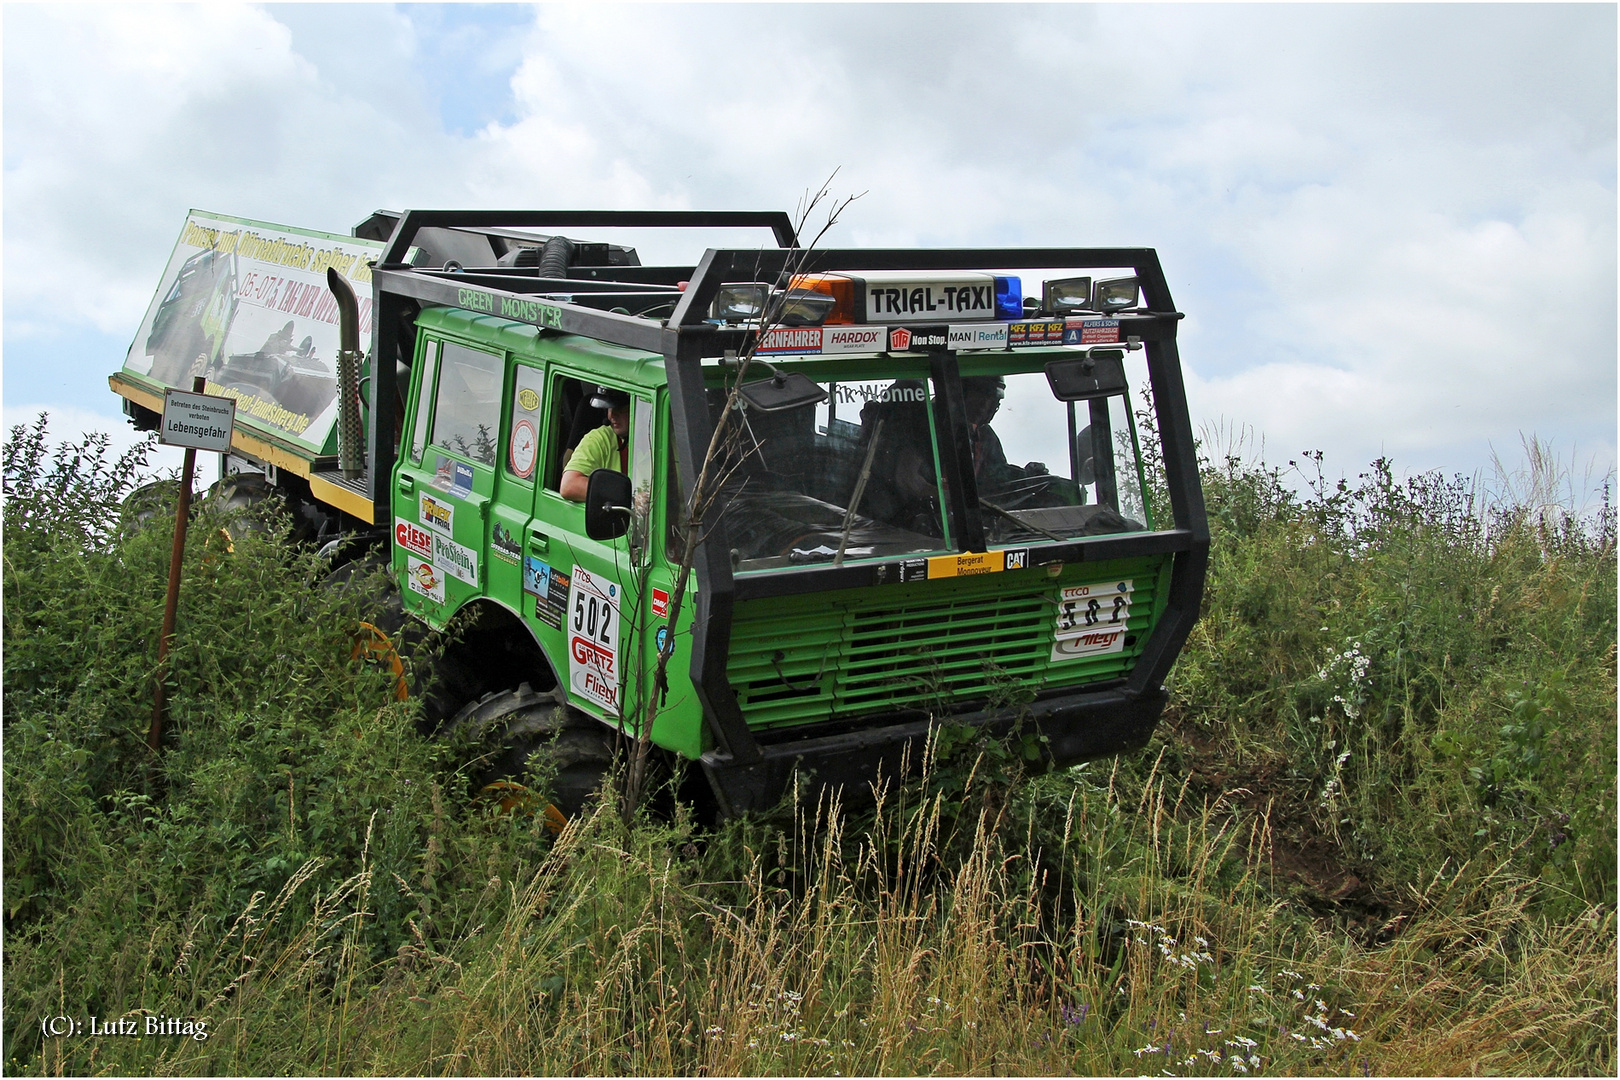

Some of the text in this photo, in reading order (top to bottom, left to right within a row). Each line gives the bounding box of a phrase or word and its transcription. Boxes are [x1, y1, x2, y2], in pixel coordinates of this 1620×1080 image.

[216, 229, 242, 254] und
[236, 230, 314, 270] Offroadtrucks
[277, 279, 304, 313] TAG
[293, 283, 321, 318] DER
[871, 286, 992, 315] TRIAL-TAXI
[458, 288, 562, 329] GREEN MONSTER
[1010, 324, 1026, 332] KFZ
[1029, 324, 1045, 332] KFZ
[1047, 323, 1063, 331] KFZ
[831, 332, 879, 343] HARDOX
[912, 334, 947, 345] Non Stop.
[949, 330, 1007, 342] MAN Rental
[1070, 330, 1078, 341] A
[171, 400, 191, 409] Betreten
[202, 405, 229, 415] Steinbruchs
[189, 413, 210, 421] verboten
[168, 419, 227, 438] Lebensgefahr
[422, 497, 451, 522] TRUCK
[434, 516, 450, 531] TRIAL
[435, 535, 470, 570] ProStein
[957, 556, 984, 566] Bergerat
[1007, 552, 1025, 570] CAT
[574, 591, 611, 644] 502
[1062, 596, 1126, 630] 502
[585, 673, 617, 705] Fliegl
